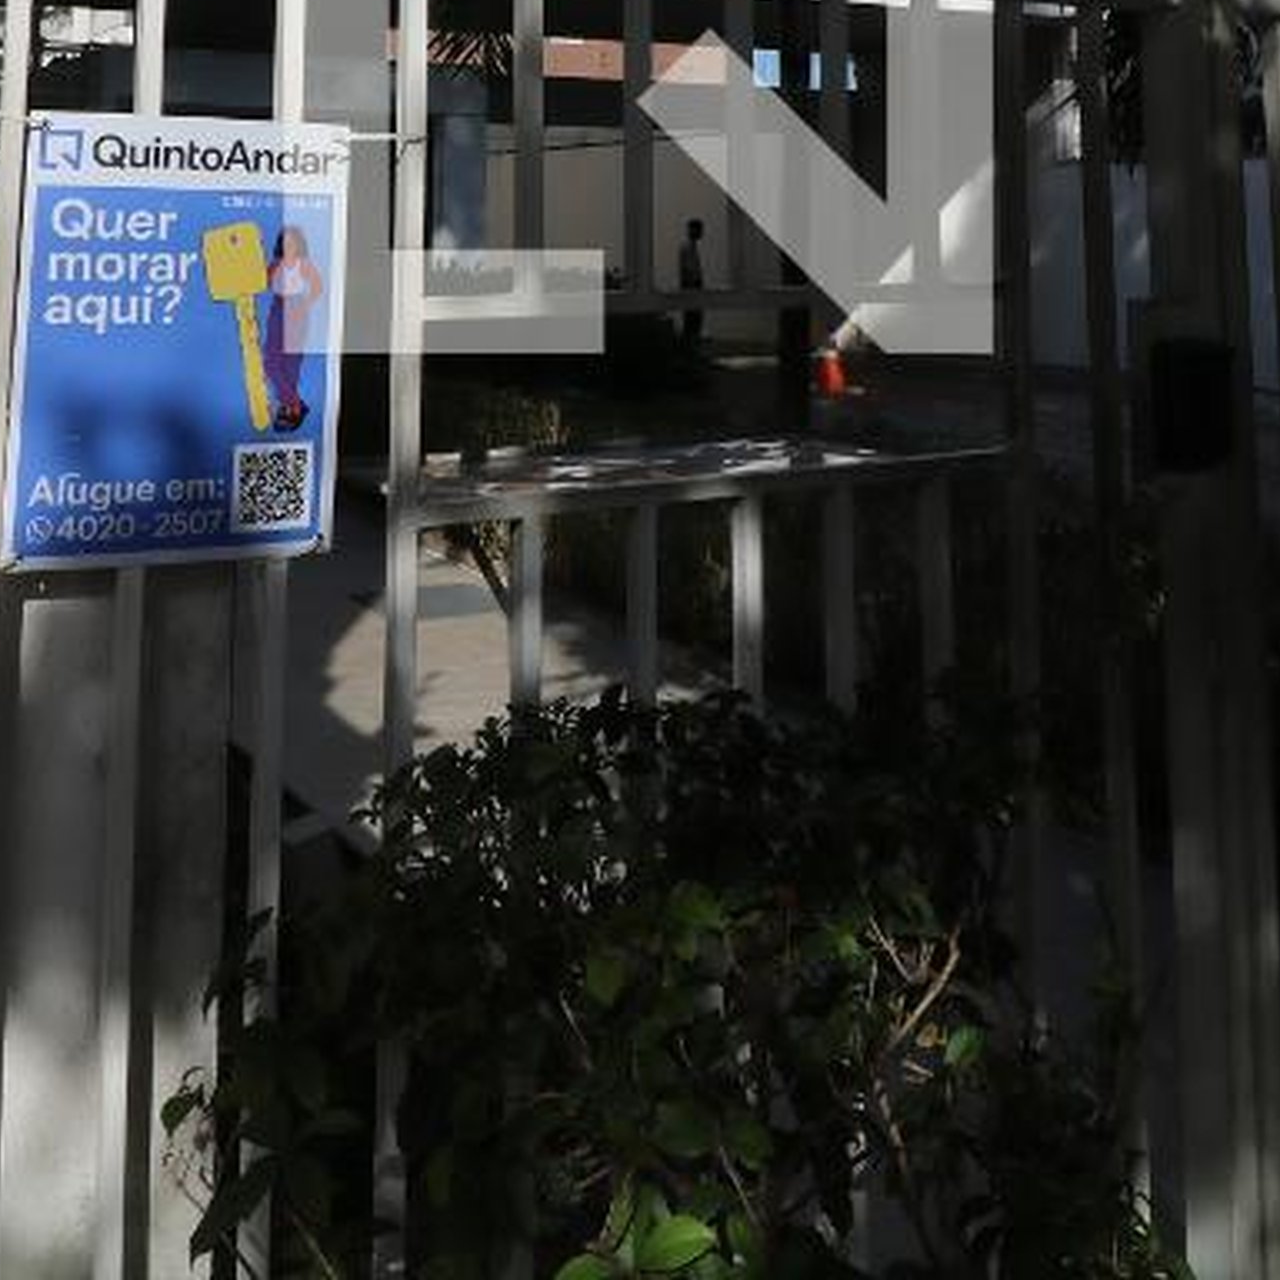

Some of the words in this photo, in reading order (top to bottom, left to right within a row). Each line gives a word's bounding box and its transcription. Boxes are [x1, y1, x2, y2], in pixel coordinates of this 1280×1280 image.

[92, 134, 337, 178] QuintoAndar
[52, 198, 178, 241] Quer
[48, 251, 198, 284] morar
[43, 284, 183, 336] aqui?
[26, 474, 156, 512] Alugue
[165, 477, 226, 503] em:
